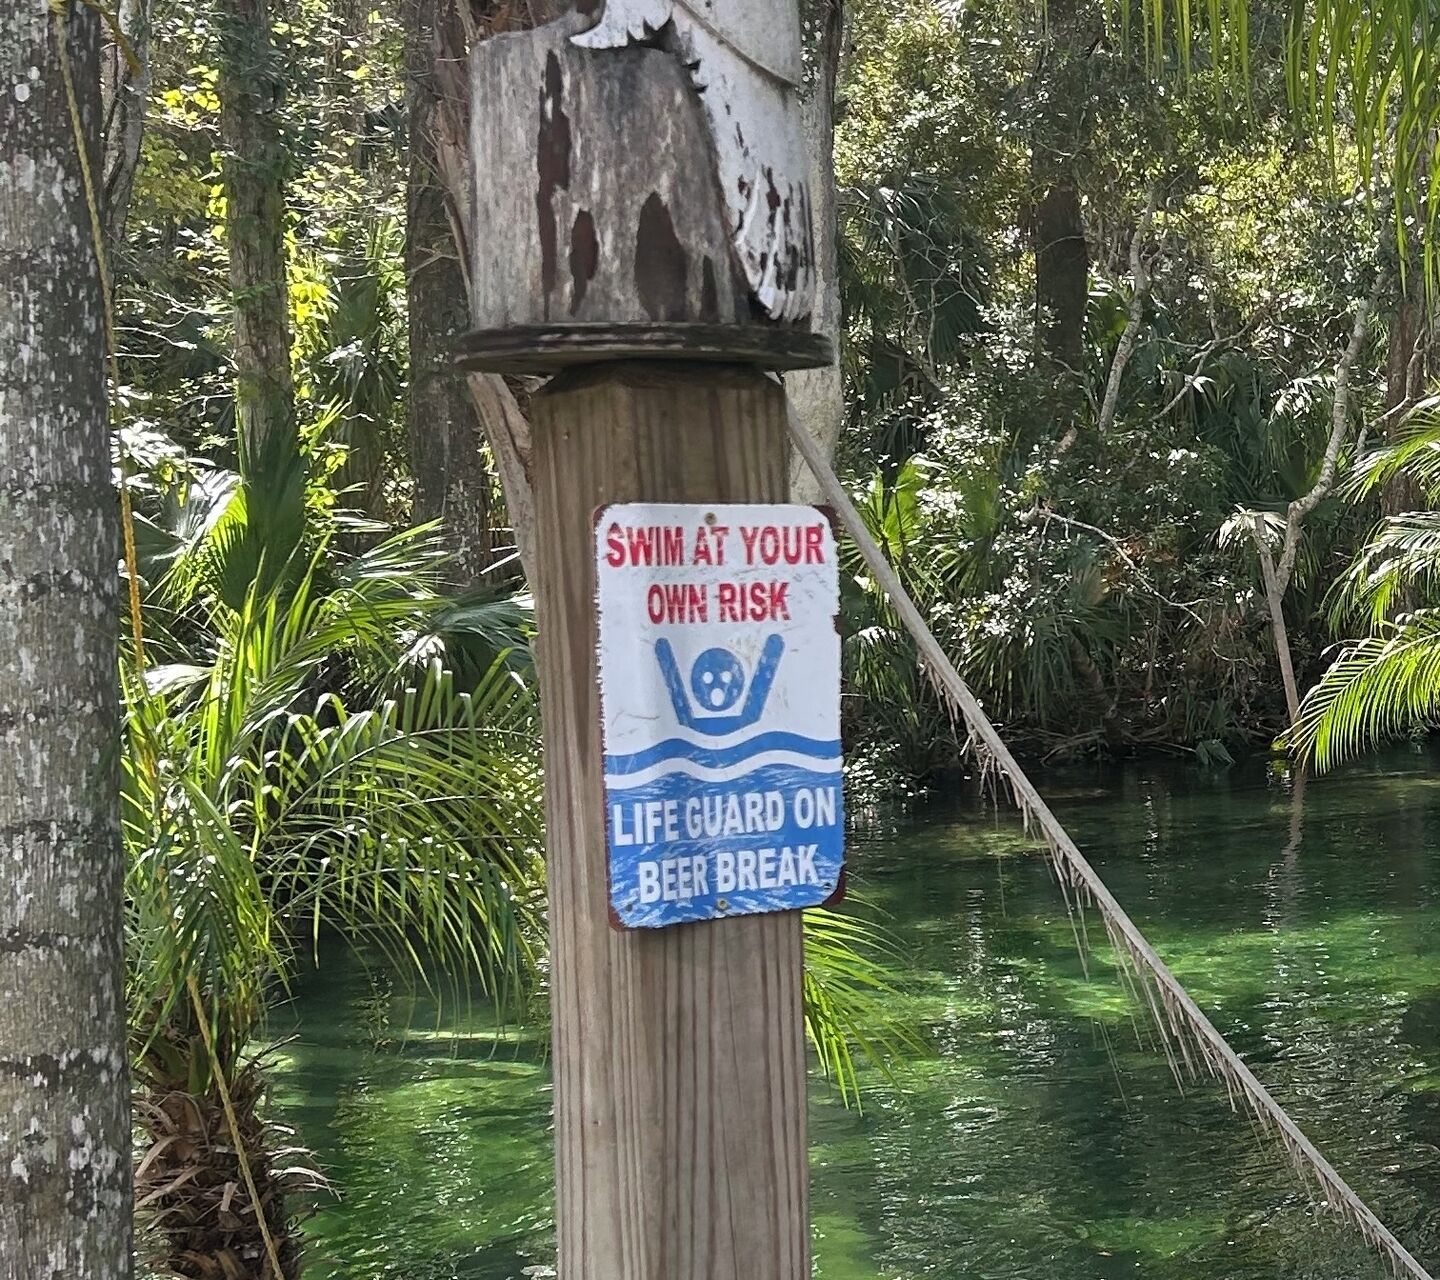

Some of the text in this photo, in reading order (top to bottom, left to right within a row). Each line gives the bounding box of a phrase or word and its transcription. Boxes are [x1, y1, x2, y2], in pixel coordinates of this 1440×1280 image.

[607, 522, 826, 568] SWIM AT YOUR
[647, 581, 791, 625] OWN RISK
[613, 786, 837, 847] LIFE GUARD ON
[638, 843, 820, 904] BEER BREAK
